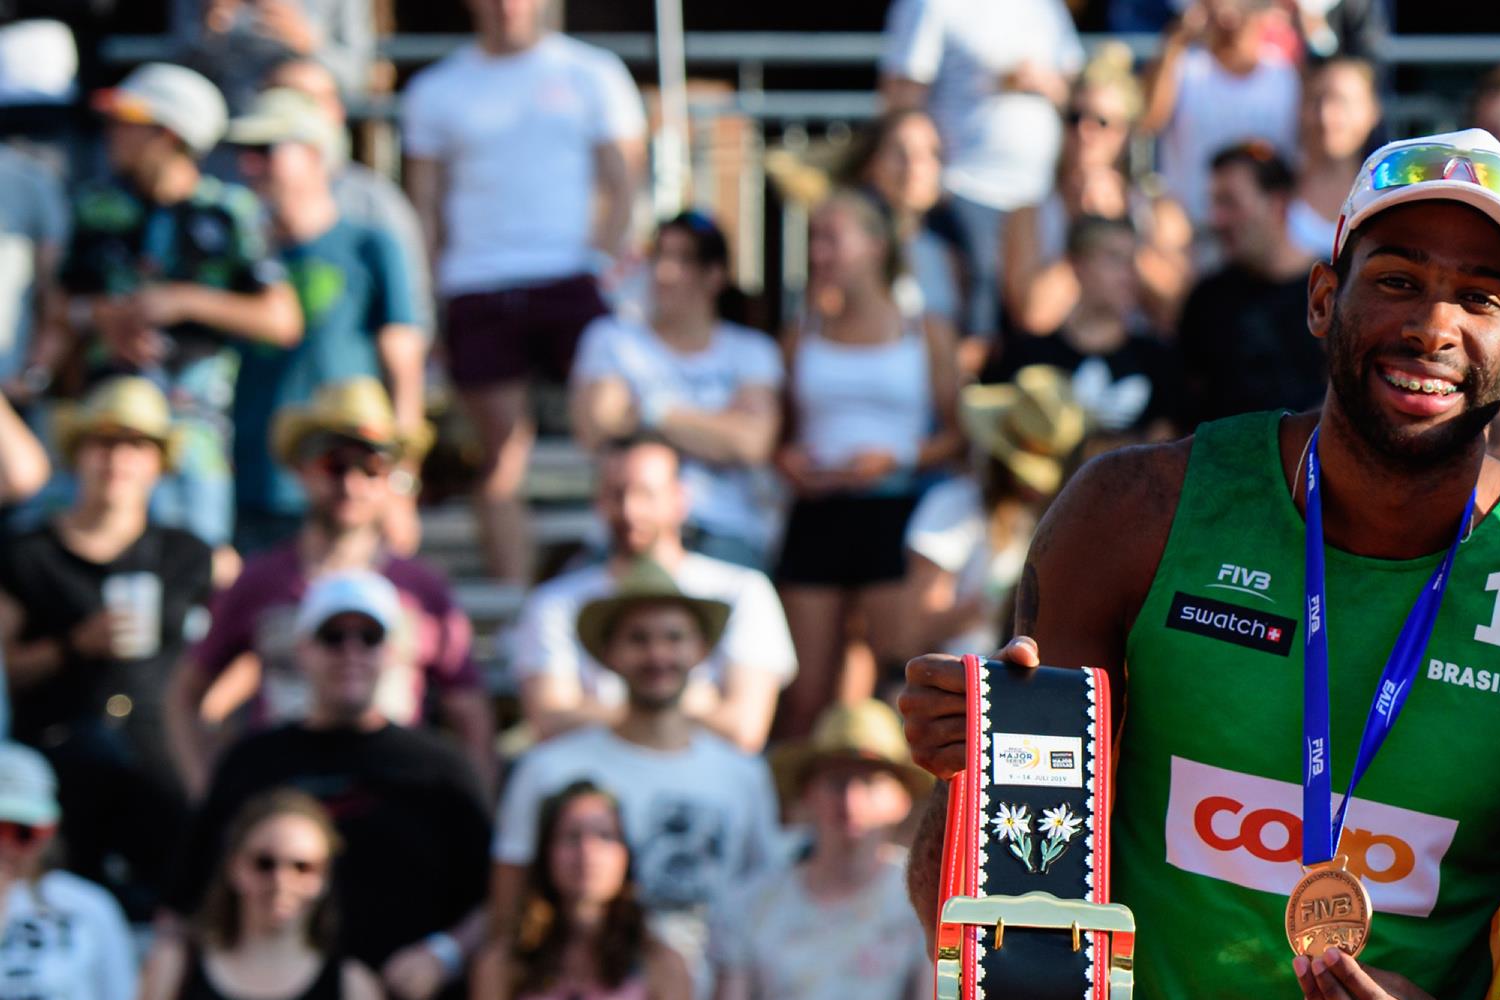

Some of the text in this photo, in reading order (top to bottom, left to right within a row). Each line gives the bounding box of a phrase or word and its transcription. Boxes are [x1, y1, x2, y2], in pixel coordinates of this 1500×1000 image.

[1217, 563, 1271, 590] FIVB
[1180, 606, 1266, 639] swatch
[1311, 594, 1320, 633] FIVB
[1375, 678, 1396, 716] FIVB
[999, 752, 1033, 760] MAJOR
[1312, 737, 1324, 777] FIVB
[1194, 795, 1416, 884] cop
[1300, 893, 1353, 923] FIVB
